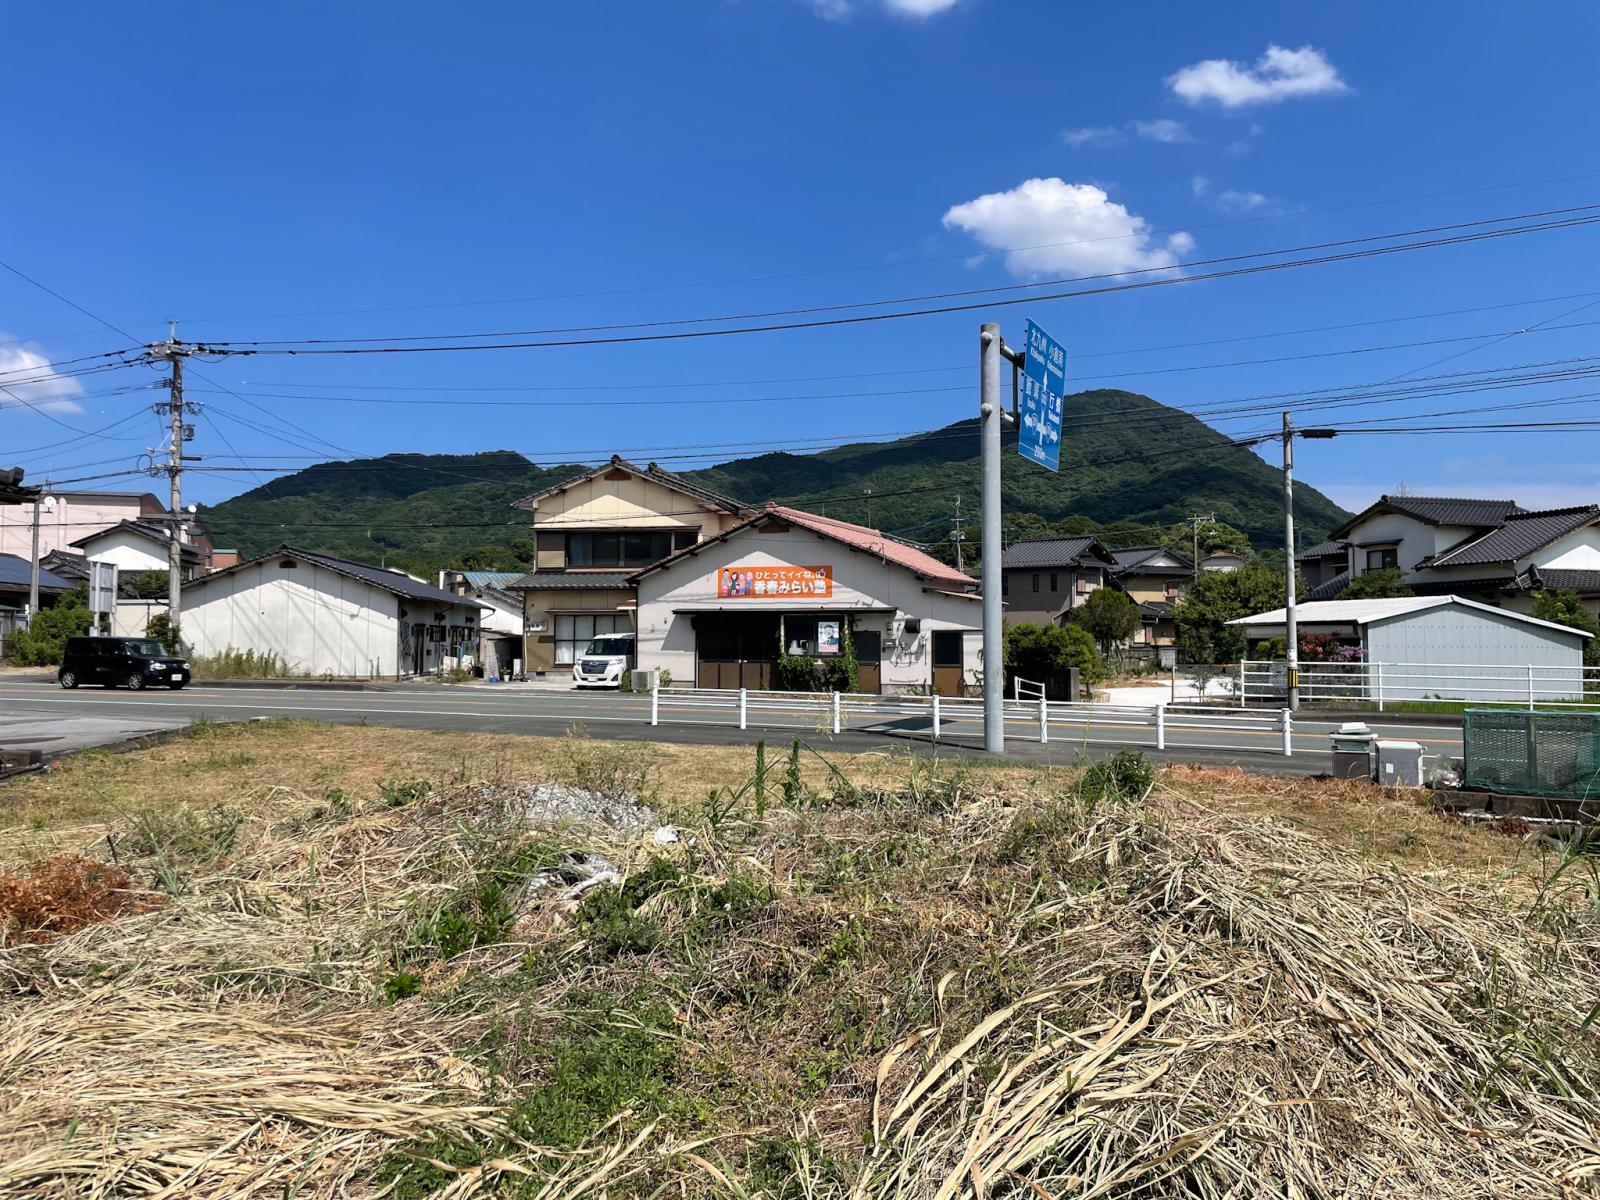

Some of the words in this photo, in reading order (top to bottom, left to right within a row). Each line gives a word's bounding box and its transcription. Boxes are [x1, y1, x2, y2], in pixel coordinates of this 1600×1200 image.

[754, 580, 827, 595] 香春みらい塾
